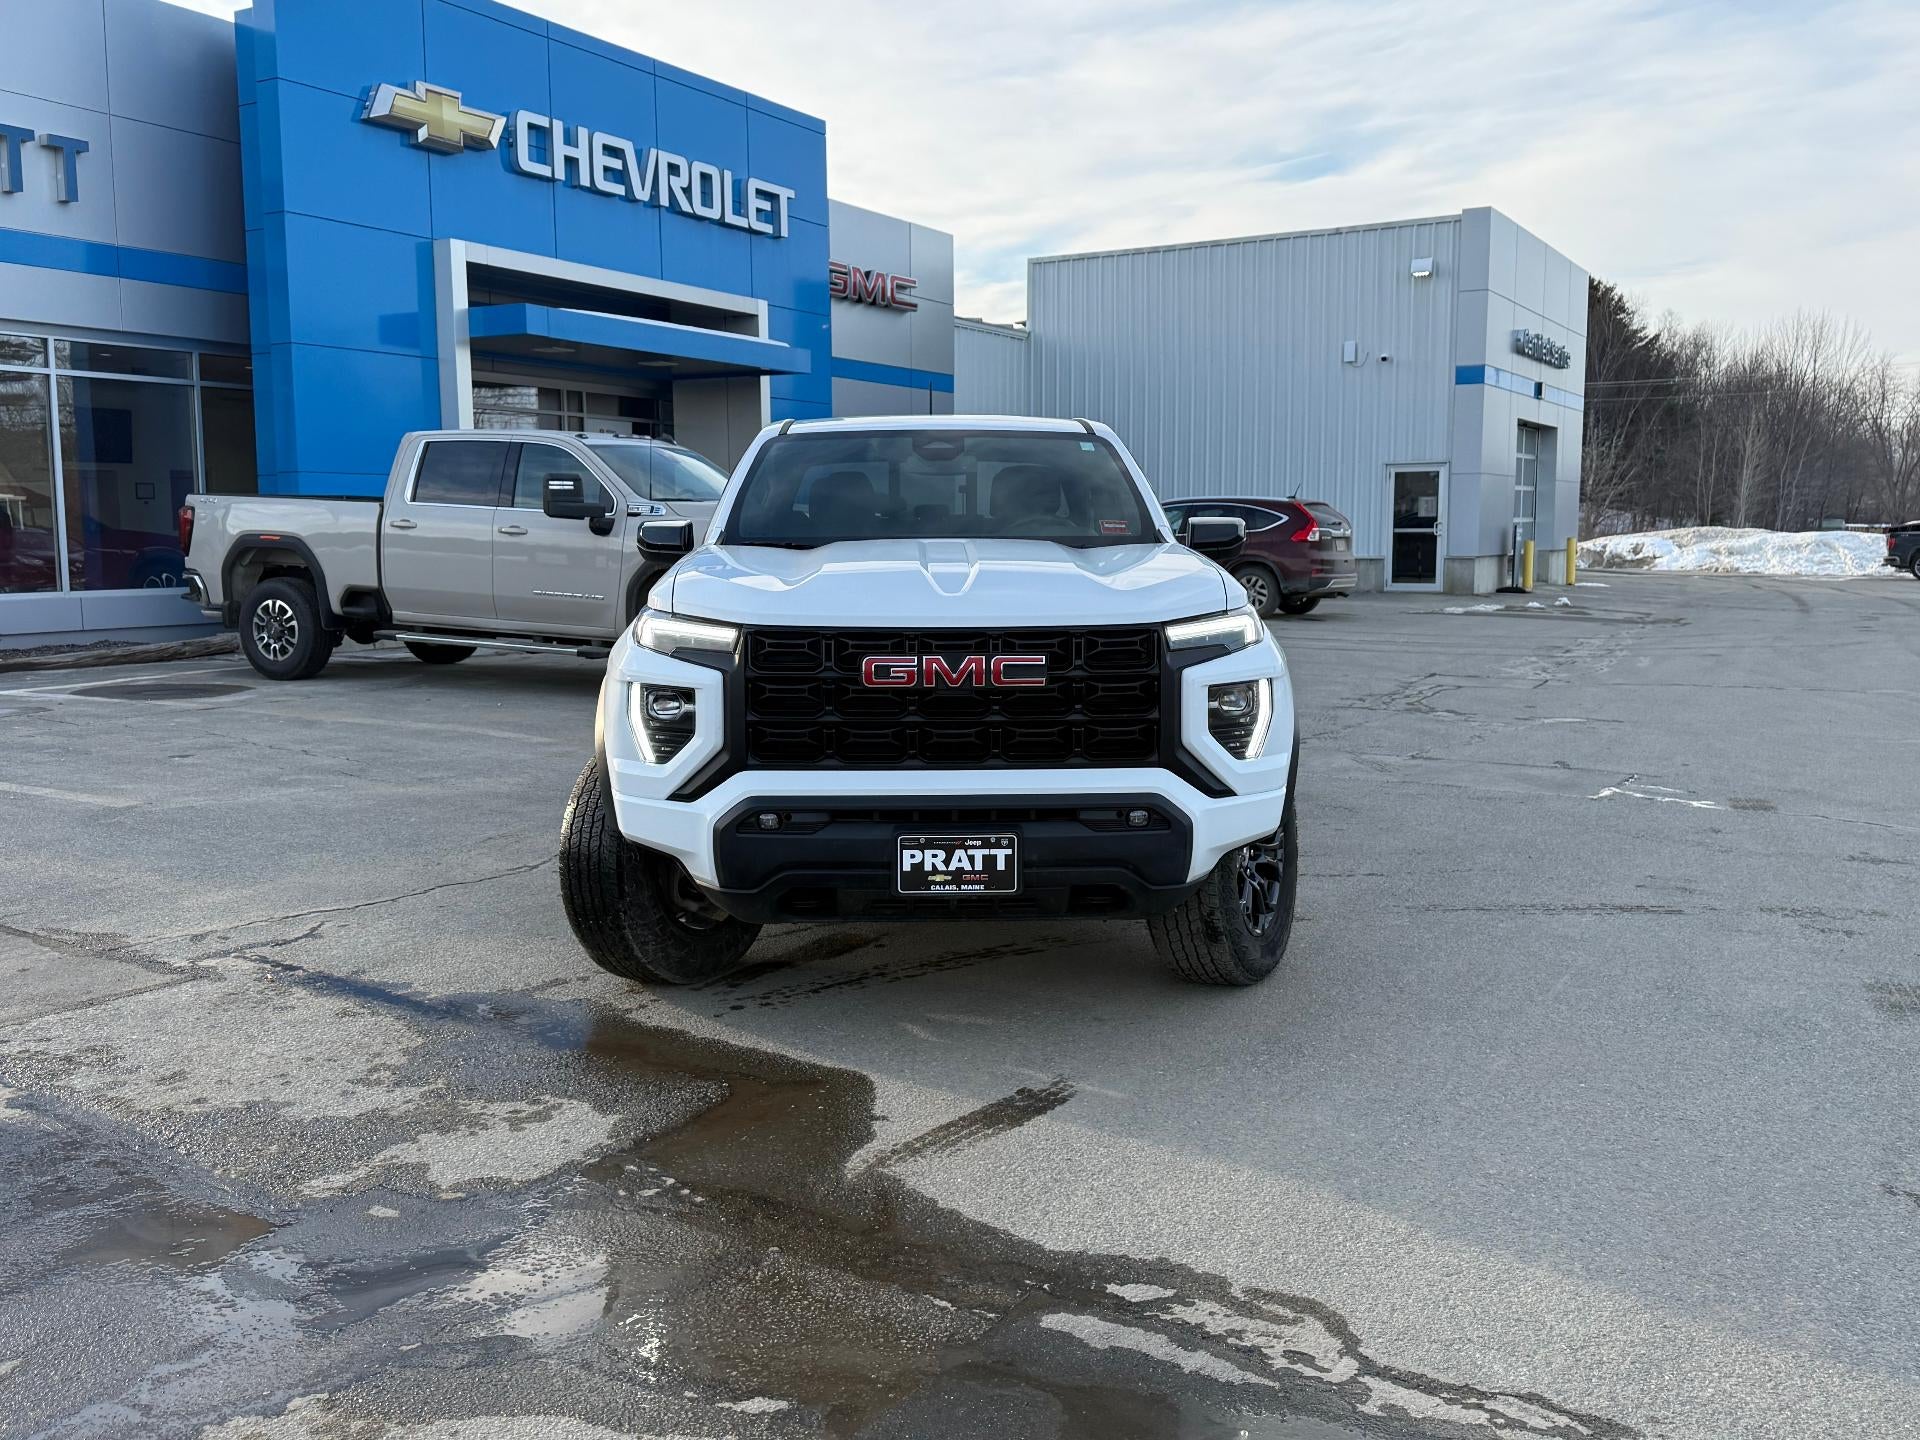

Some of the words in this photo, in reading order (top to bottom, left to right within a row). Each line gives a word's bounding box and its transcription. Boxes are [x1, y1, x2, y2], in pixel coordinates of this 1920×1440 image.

[514, 109, 796, 238] CHEVROLET
[829, 259, 918, 312] GMC
[862, 655, 1046, 688] GMC
[964, 839, 982, 847] Jeep
[902, 849, 1012, 871] PRATT
